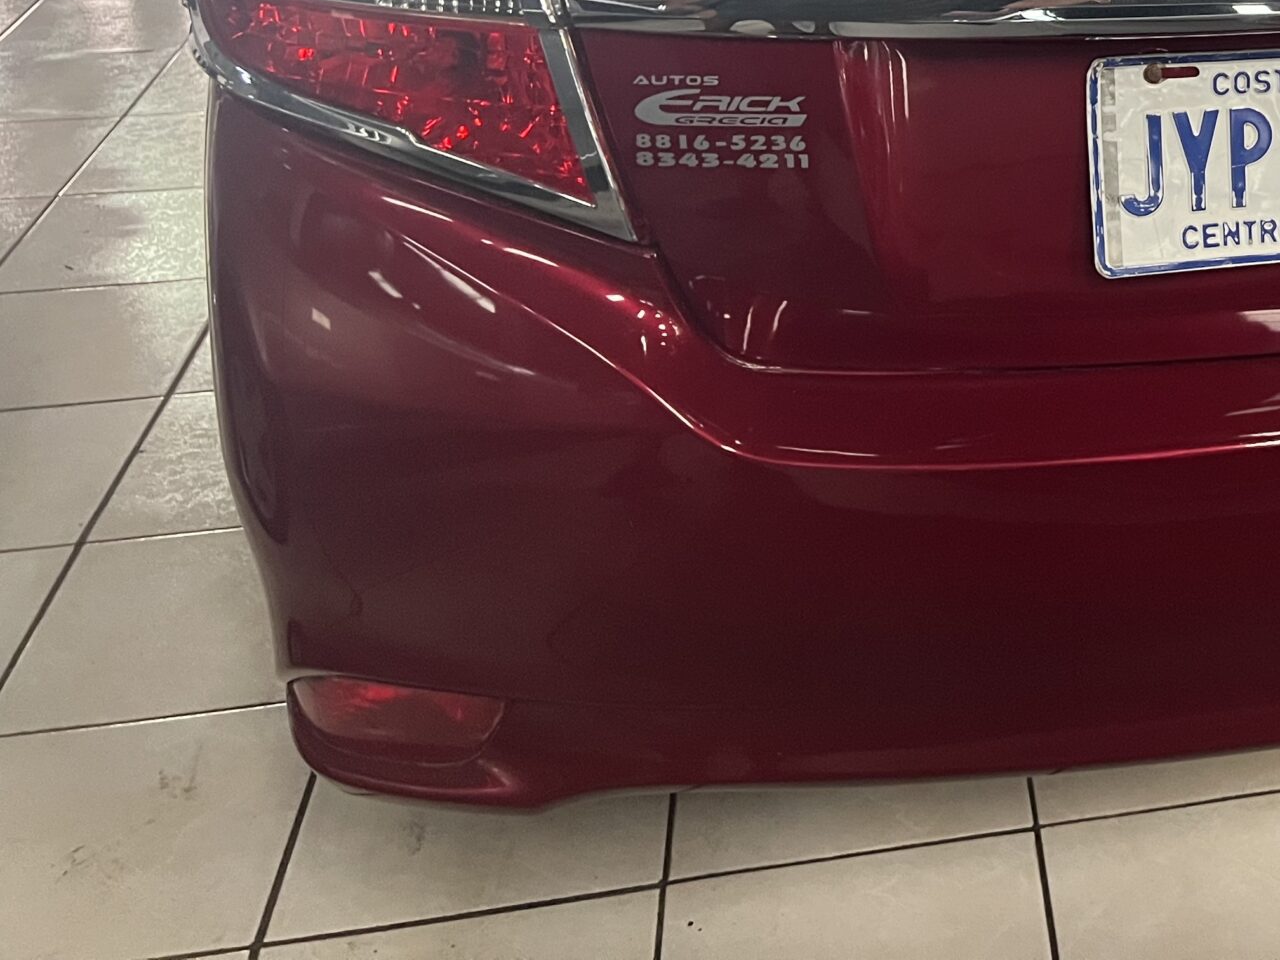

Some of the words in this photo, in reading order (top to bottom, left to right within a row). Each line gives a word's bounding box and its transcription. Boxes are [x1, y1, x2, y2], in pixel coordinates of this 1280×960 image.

[633, 75, 719, 86] AUTOS
[635, 133, 806, 152] 8816-5236
[635, 151, 809, 169] 8343-4211
